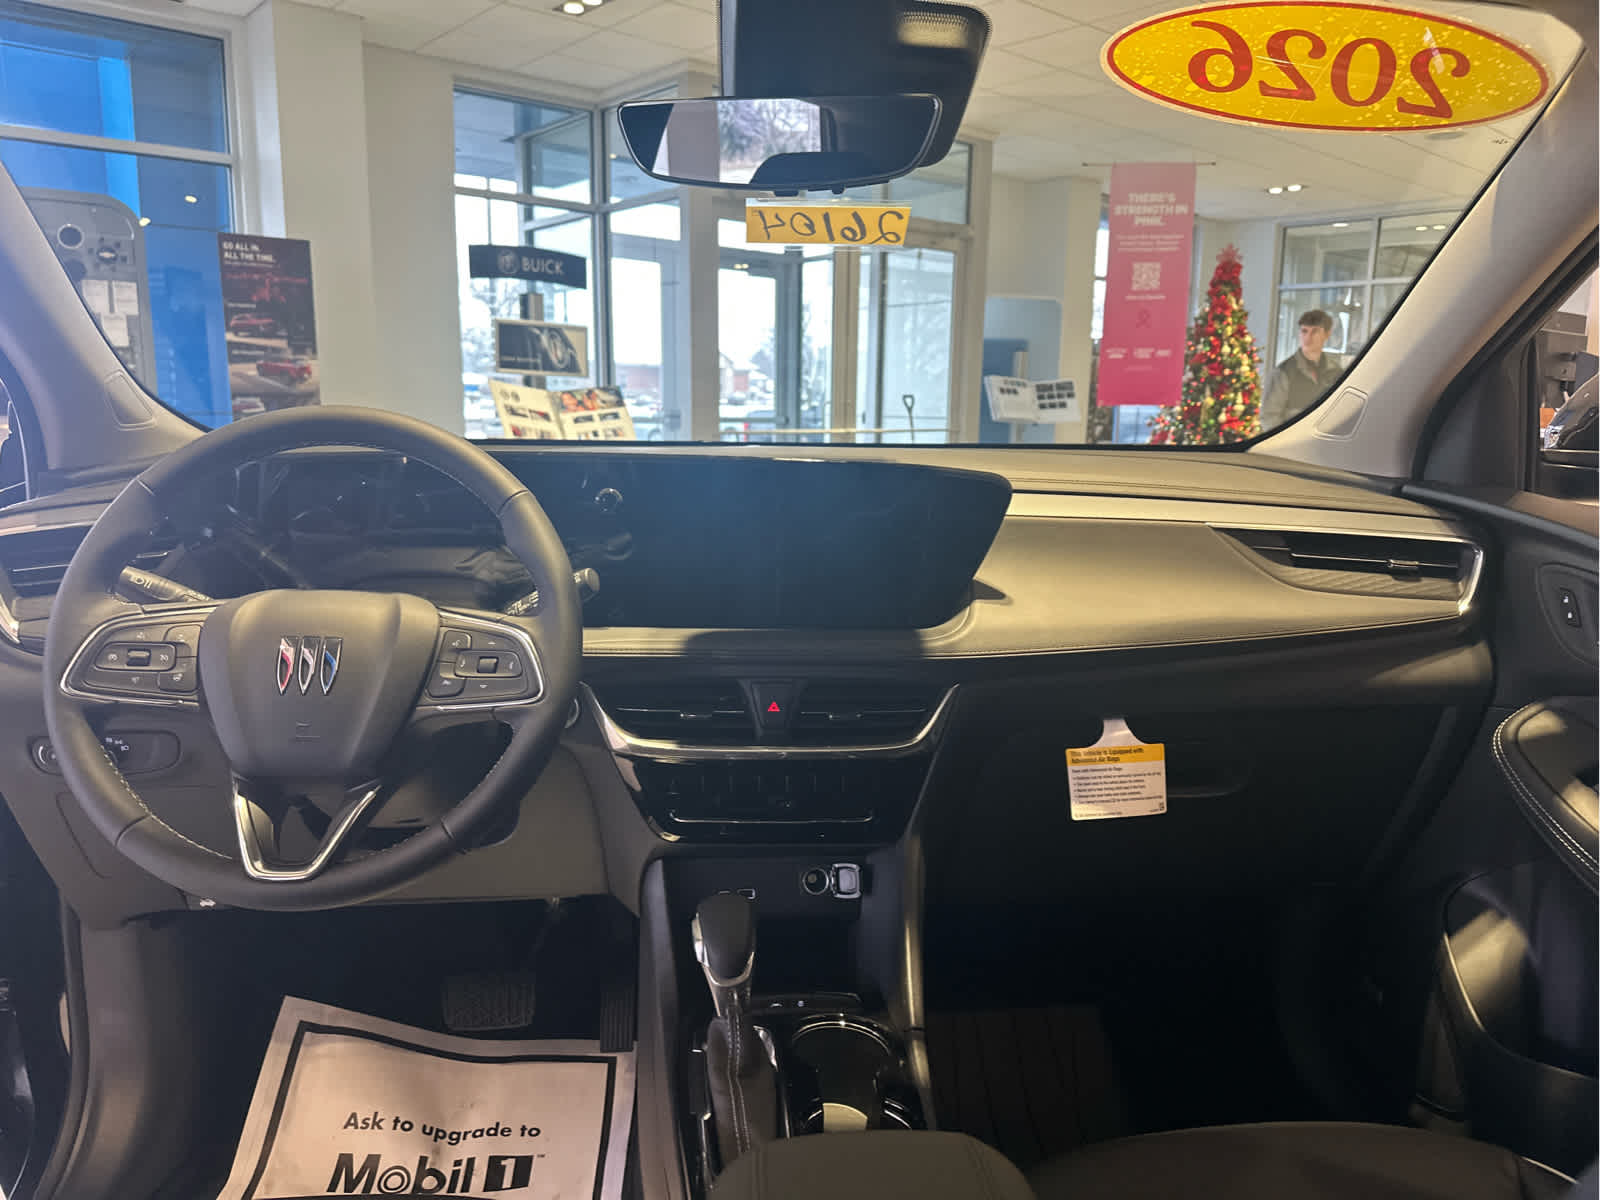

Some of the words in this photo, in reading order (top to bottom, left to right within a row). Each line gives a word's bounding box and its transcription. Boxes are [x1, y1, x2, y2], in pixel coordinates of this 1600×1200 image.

[521, 257, 564, 275] BUICK
[343, 1112, 386, 1130] Ask
[392, 1116, 414, 1132] to
[421, 1121, 513, 1146] upgrade
[520, 1124, 541, 1138] to
[326, 1152, 476, 1194] Mobil
